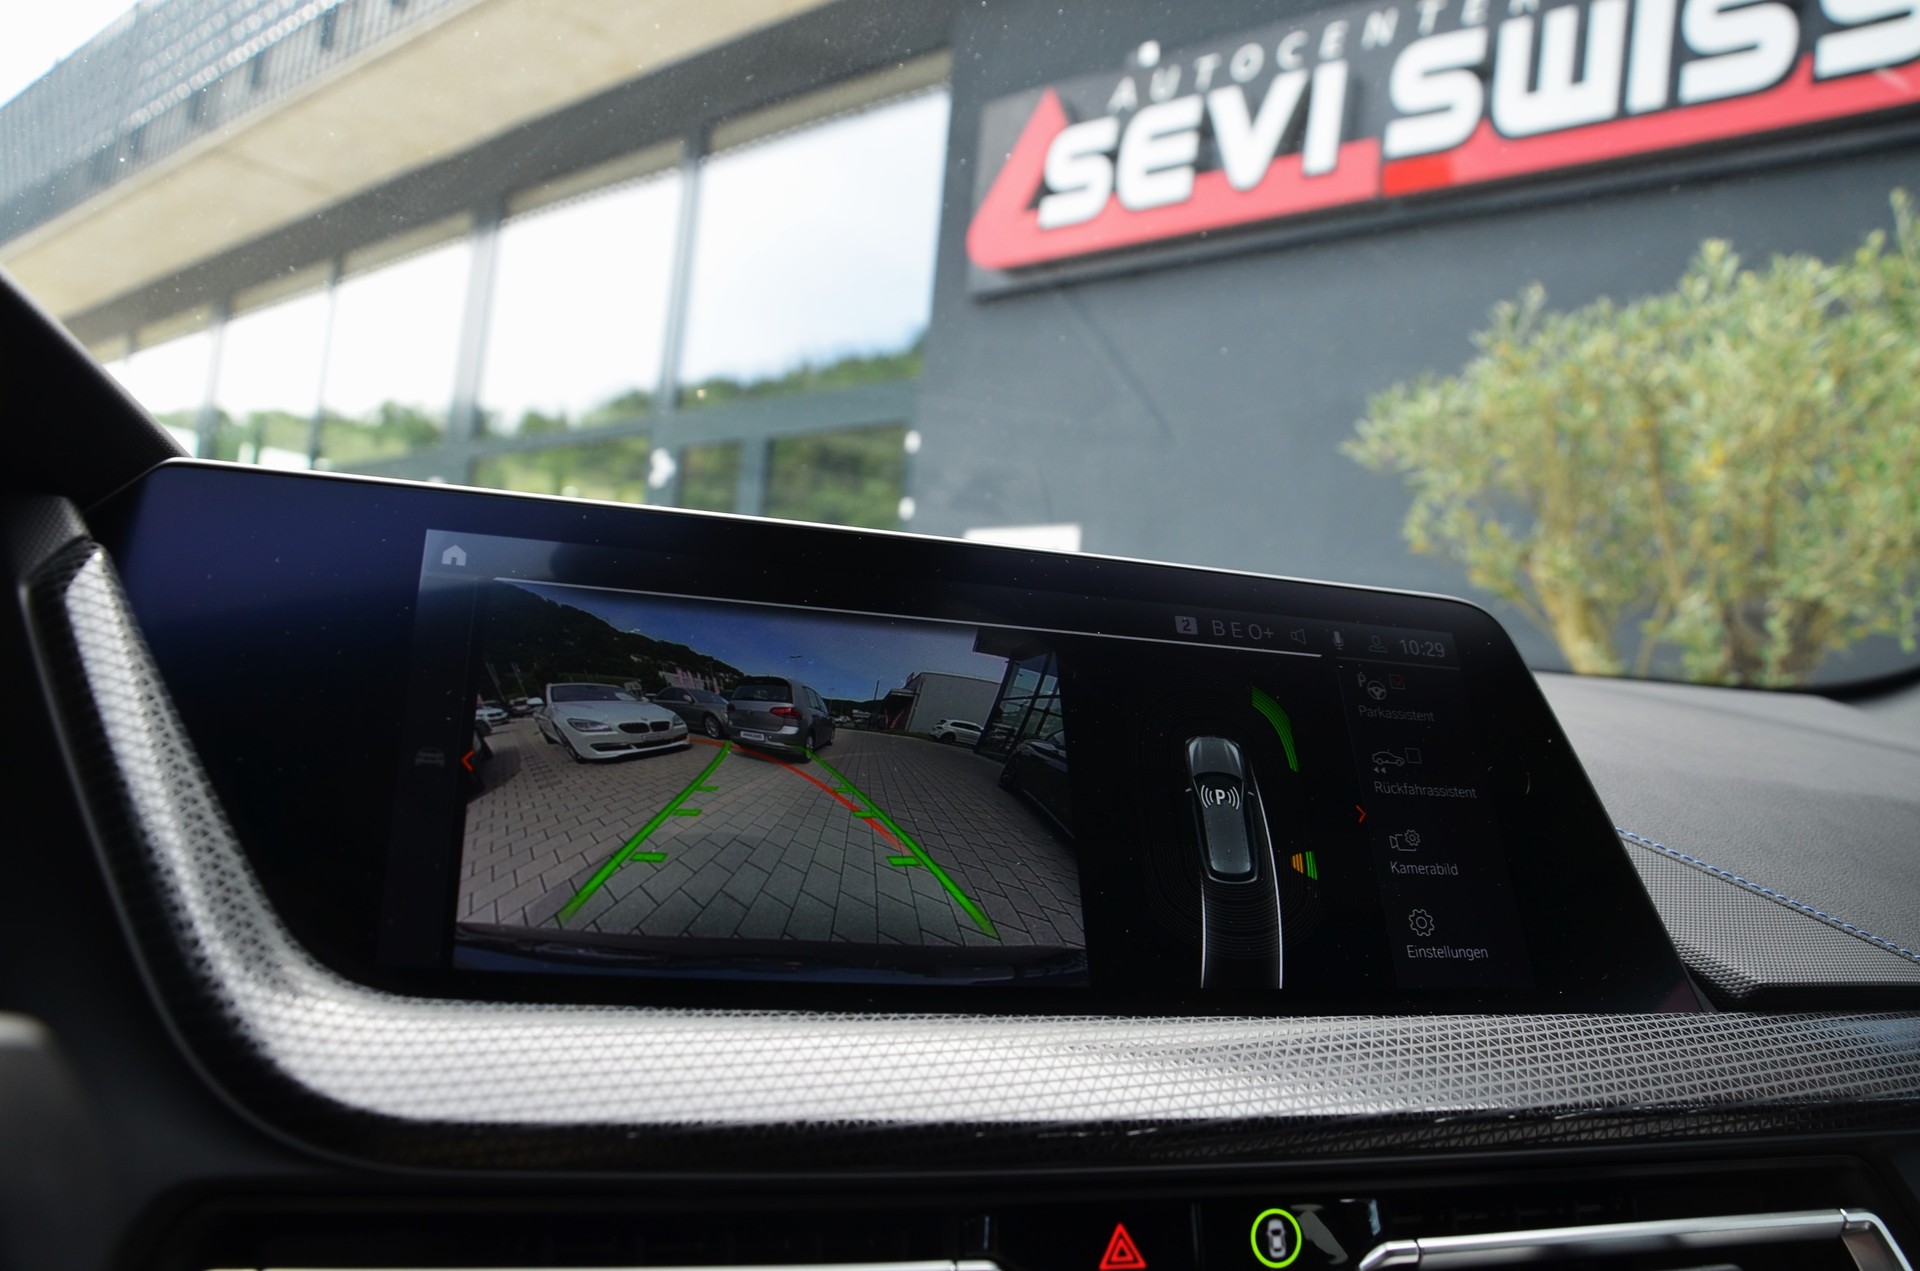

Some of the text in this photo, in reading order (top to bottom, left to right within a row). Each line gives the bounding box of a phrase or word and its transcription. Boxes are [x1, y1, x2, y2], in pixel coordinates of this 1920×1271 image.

[1037, 58, 1349, 231] SEVI
[1399, 639, 1447, 659] 10:29
[1358, 704, 1436, 722] Parkassistent
[1374, 780, 1478, 799] Rückfahrassistent
[1390, 861, 1459, 876] Kamerabild
[1406, 944, 1489, 961] Einstellungen
